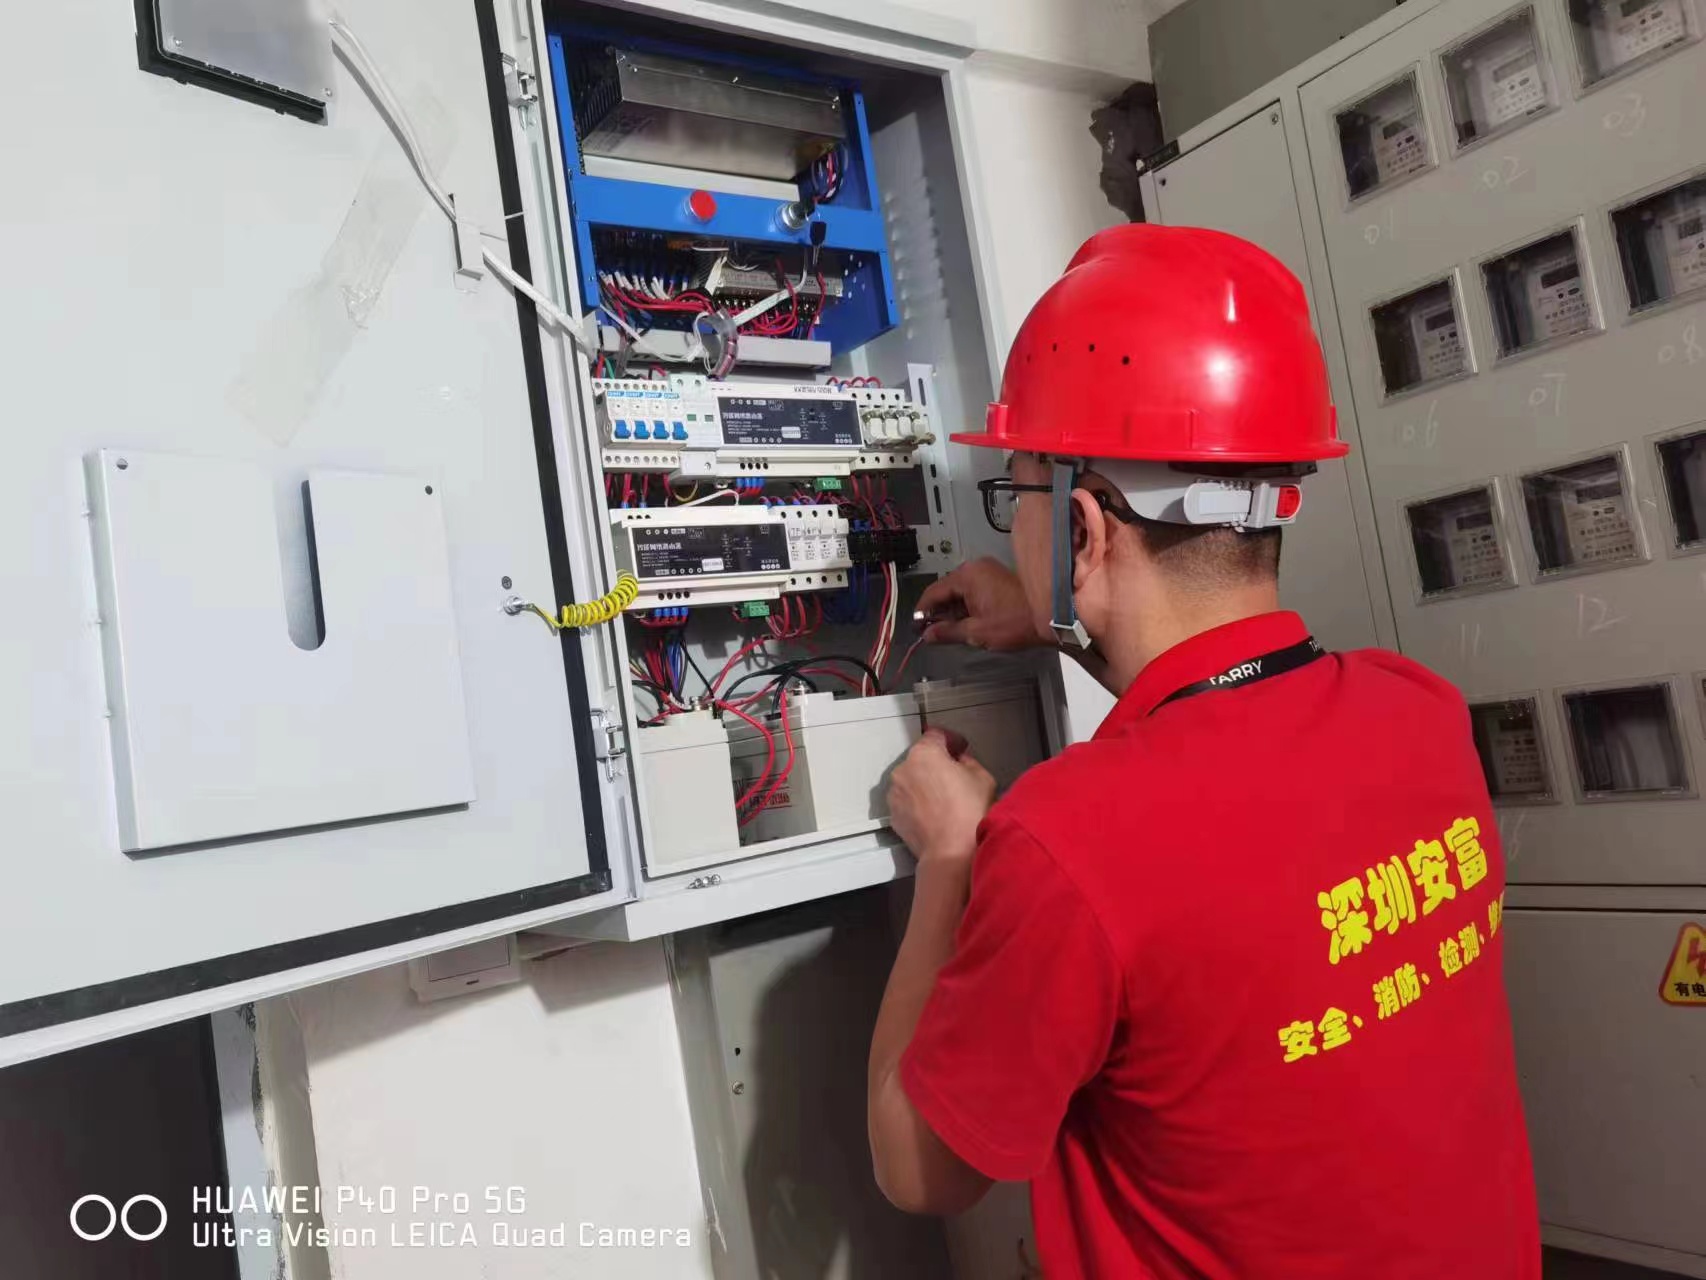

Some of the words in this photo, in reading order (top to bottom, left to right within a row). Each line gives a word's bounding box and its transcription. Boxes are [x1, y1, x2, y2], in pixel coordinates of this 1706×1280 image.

[1483, 155, 1529, 194] 02
[1364, 207, 1396, 245] 01
[1578, 593, 1628, 638] 12
[1316, 816, 1488, 965] 深圳安富
